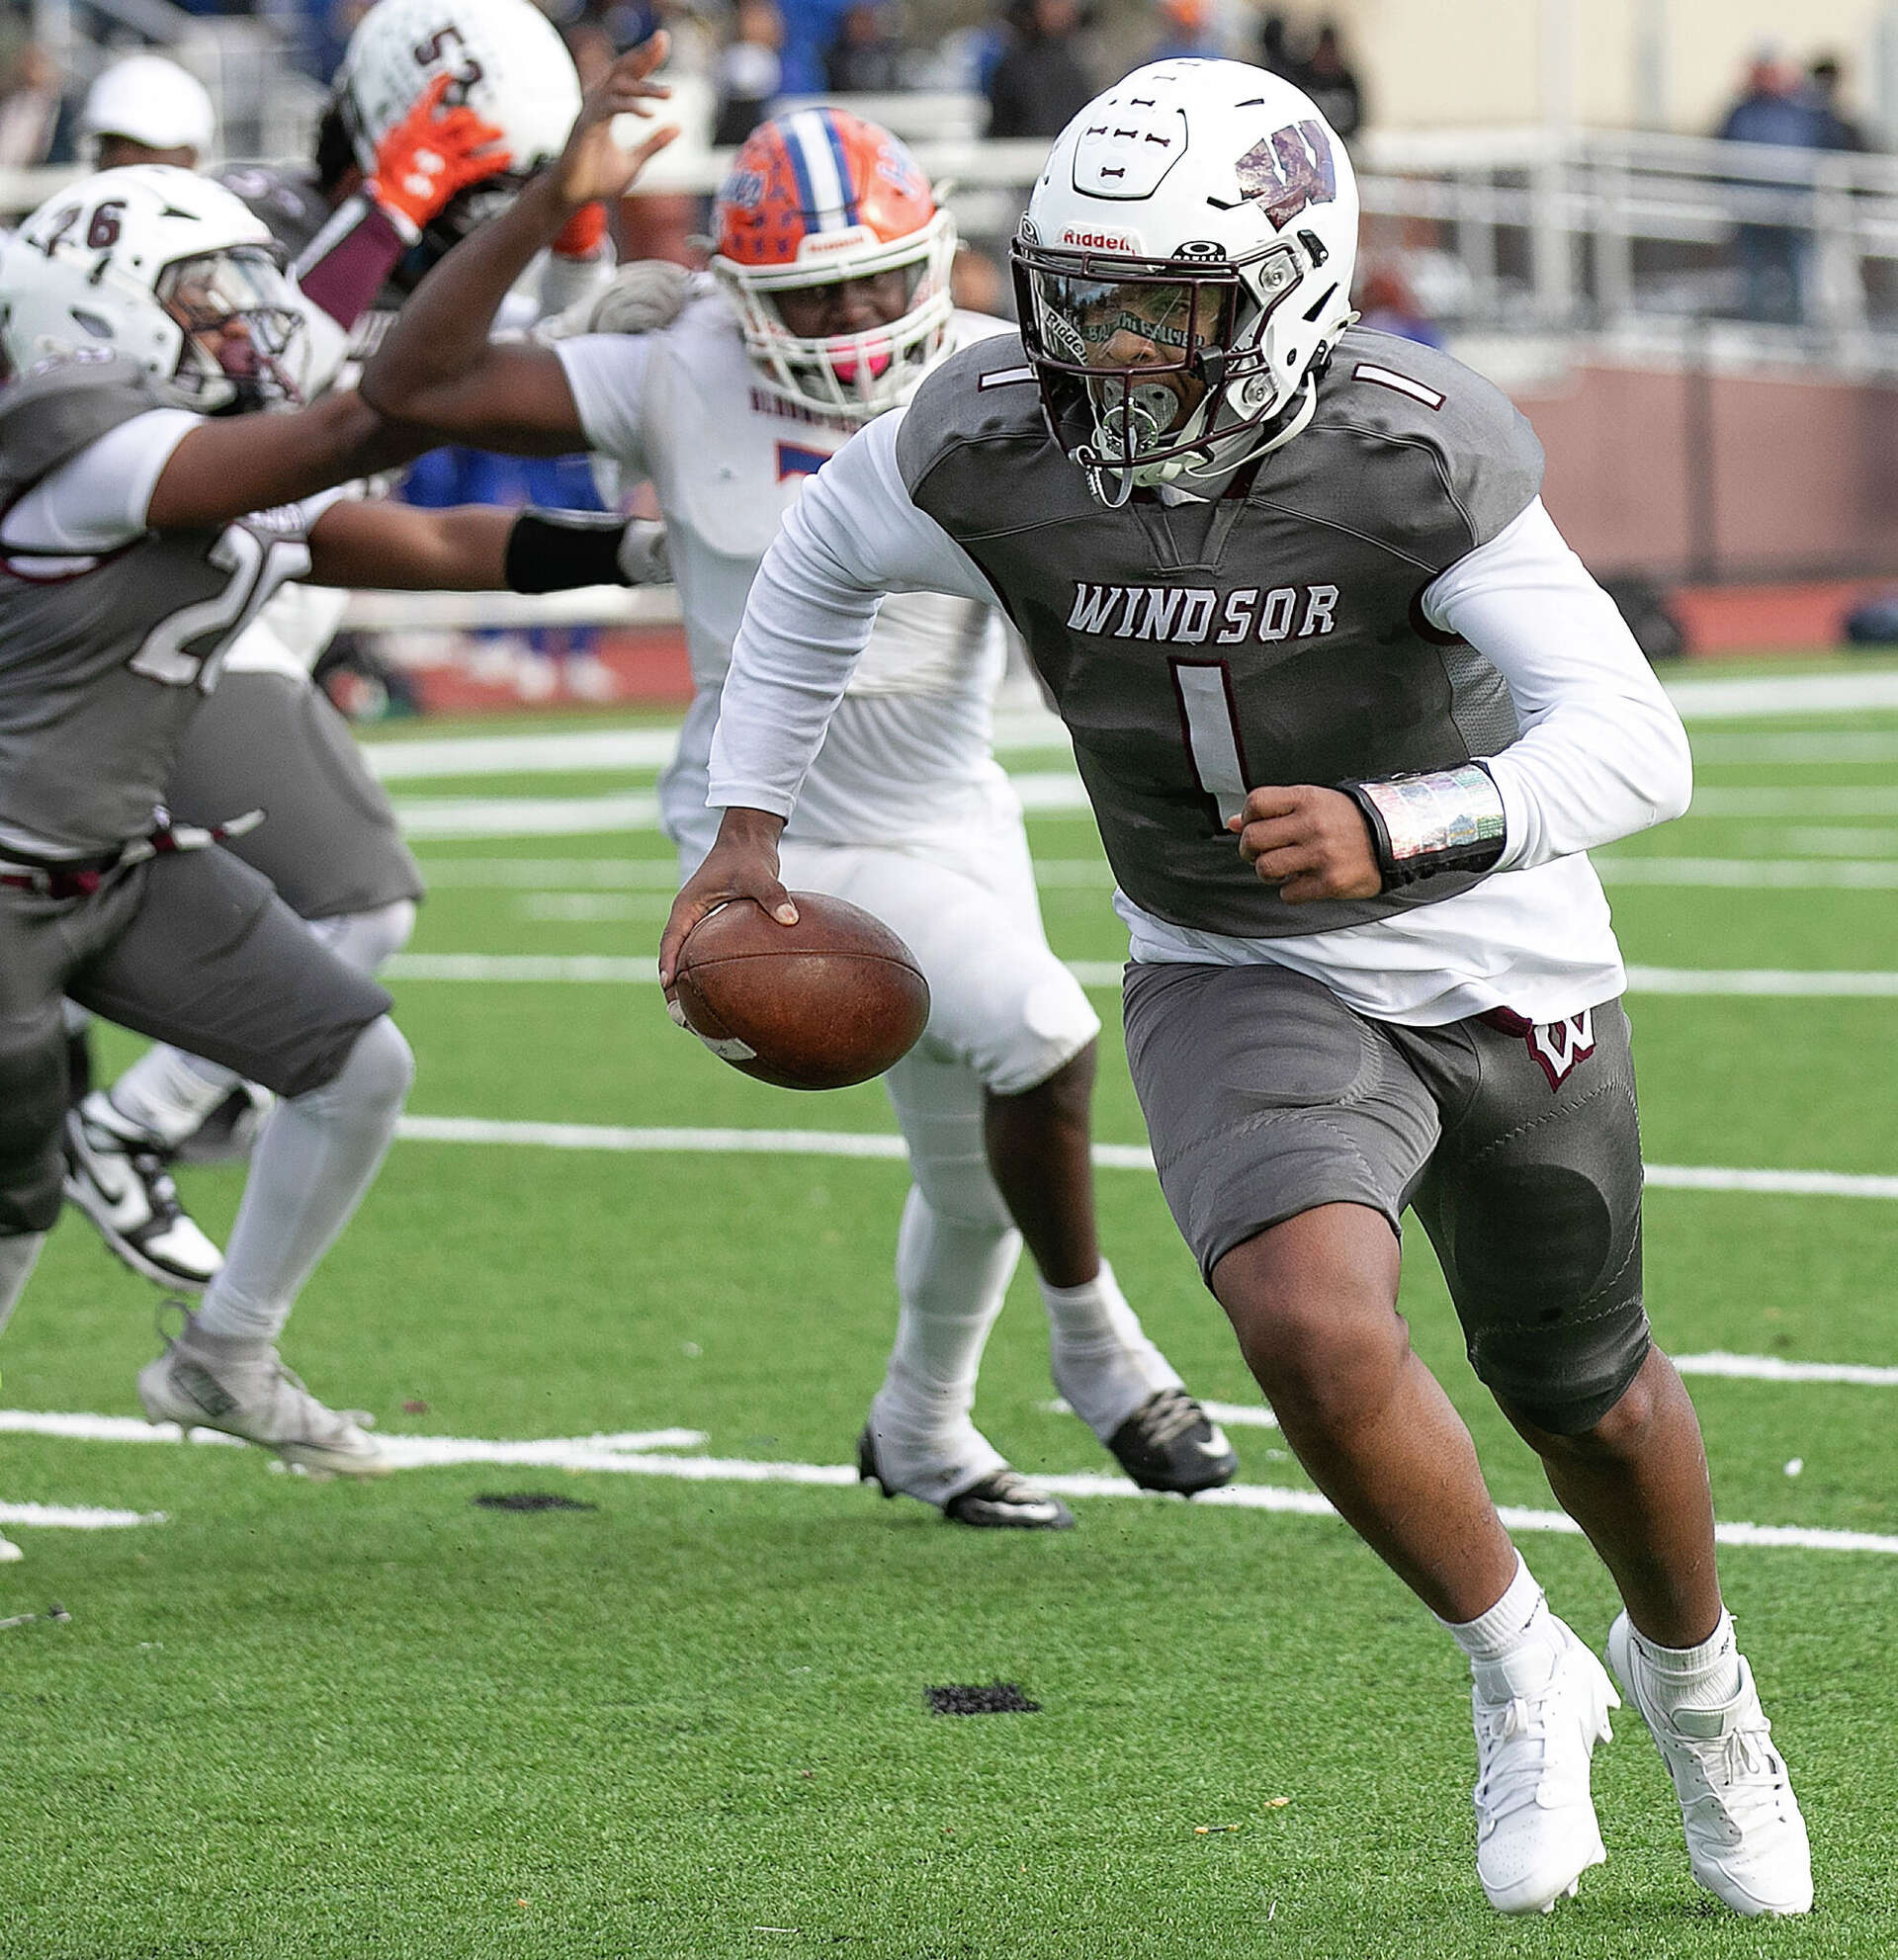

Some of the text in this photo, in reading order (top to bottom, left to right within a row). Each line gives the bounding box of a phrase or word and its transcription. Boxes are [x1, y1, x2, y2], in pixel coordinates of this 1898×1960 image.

[1234, 119, 1337, 234] W
[1066, 581, 1340, 644] WINDSOR
[1167, 656, 1253, 836] 1
[1525, 1008, 1596, 1094] W
